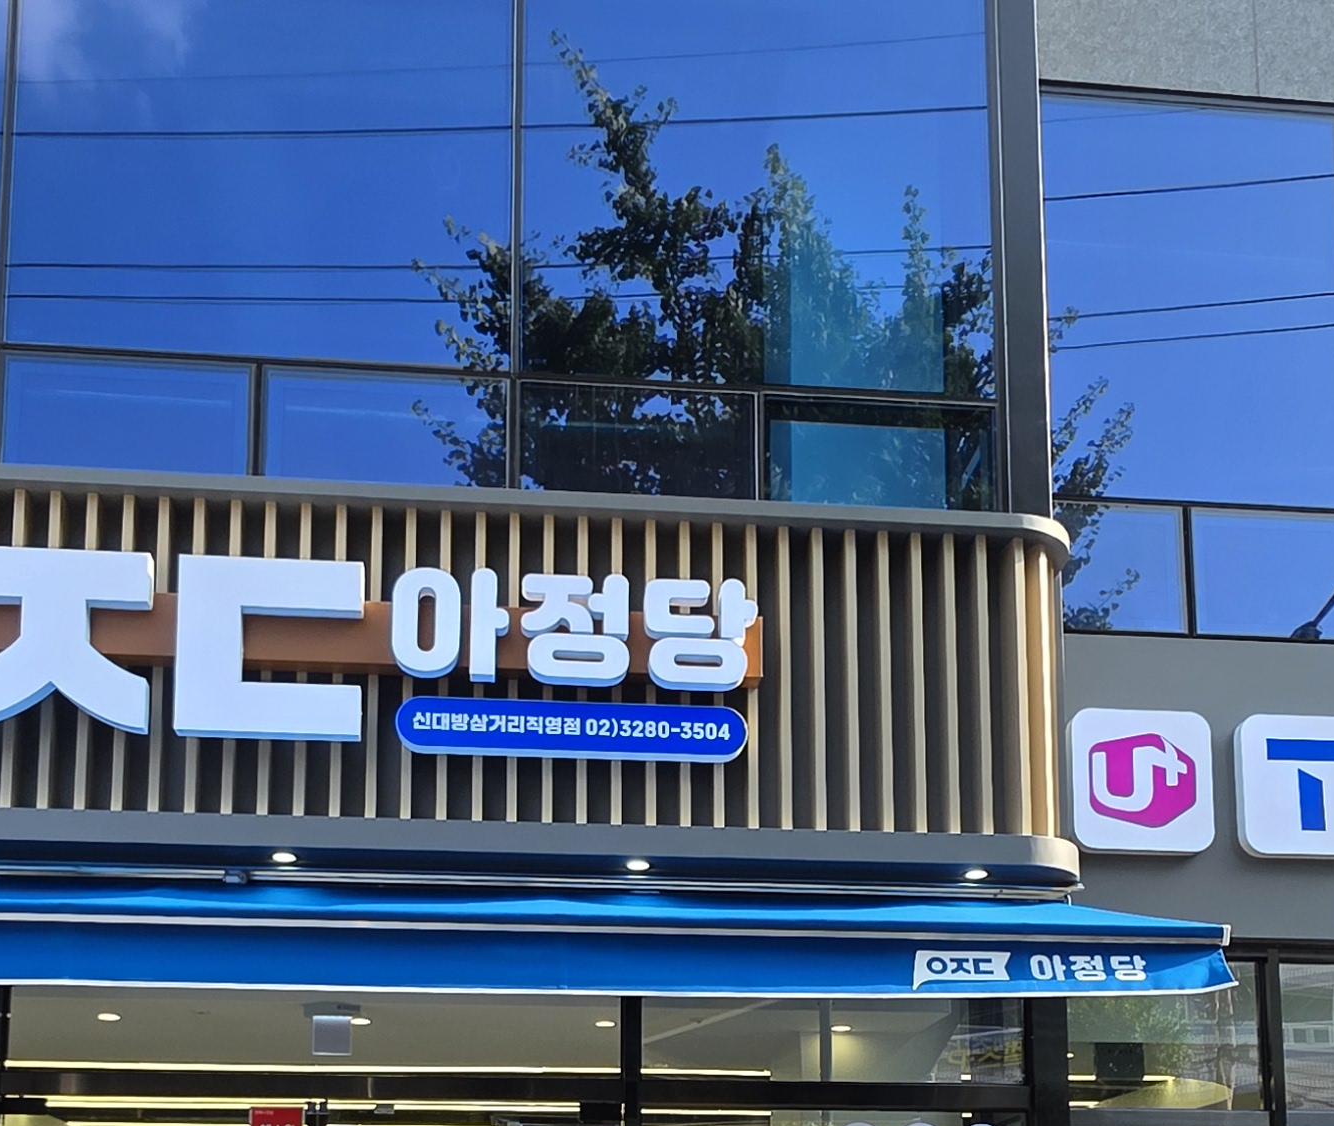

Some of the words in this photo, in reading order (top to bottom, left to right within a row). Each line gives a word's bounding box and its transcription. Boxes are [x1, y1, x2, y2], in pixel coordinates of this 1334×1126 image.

[391, 566, 759, 692] 아정당
[411, 710, 582, 737] 신대방삼거리직영점
[584, 721, 732, 741] 02)3280-3504
[1029, 953, 1148, 982] 아정당
